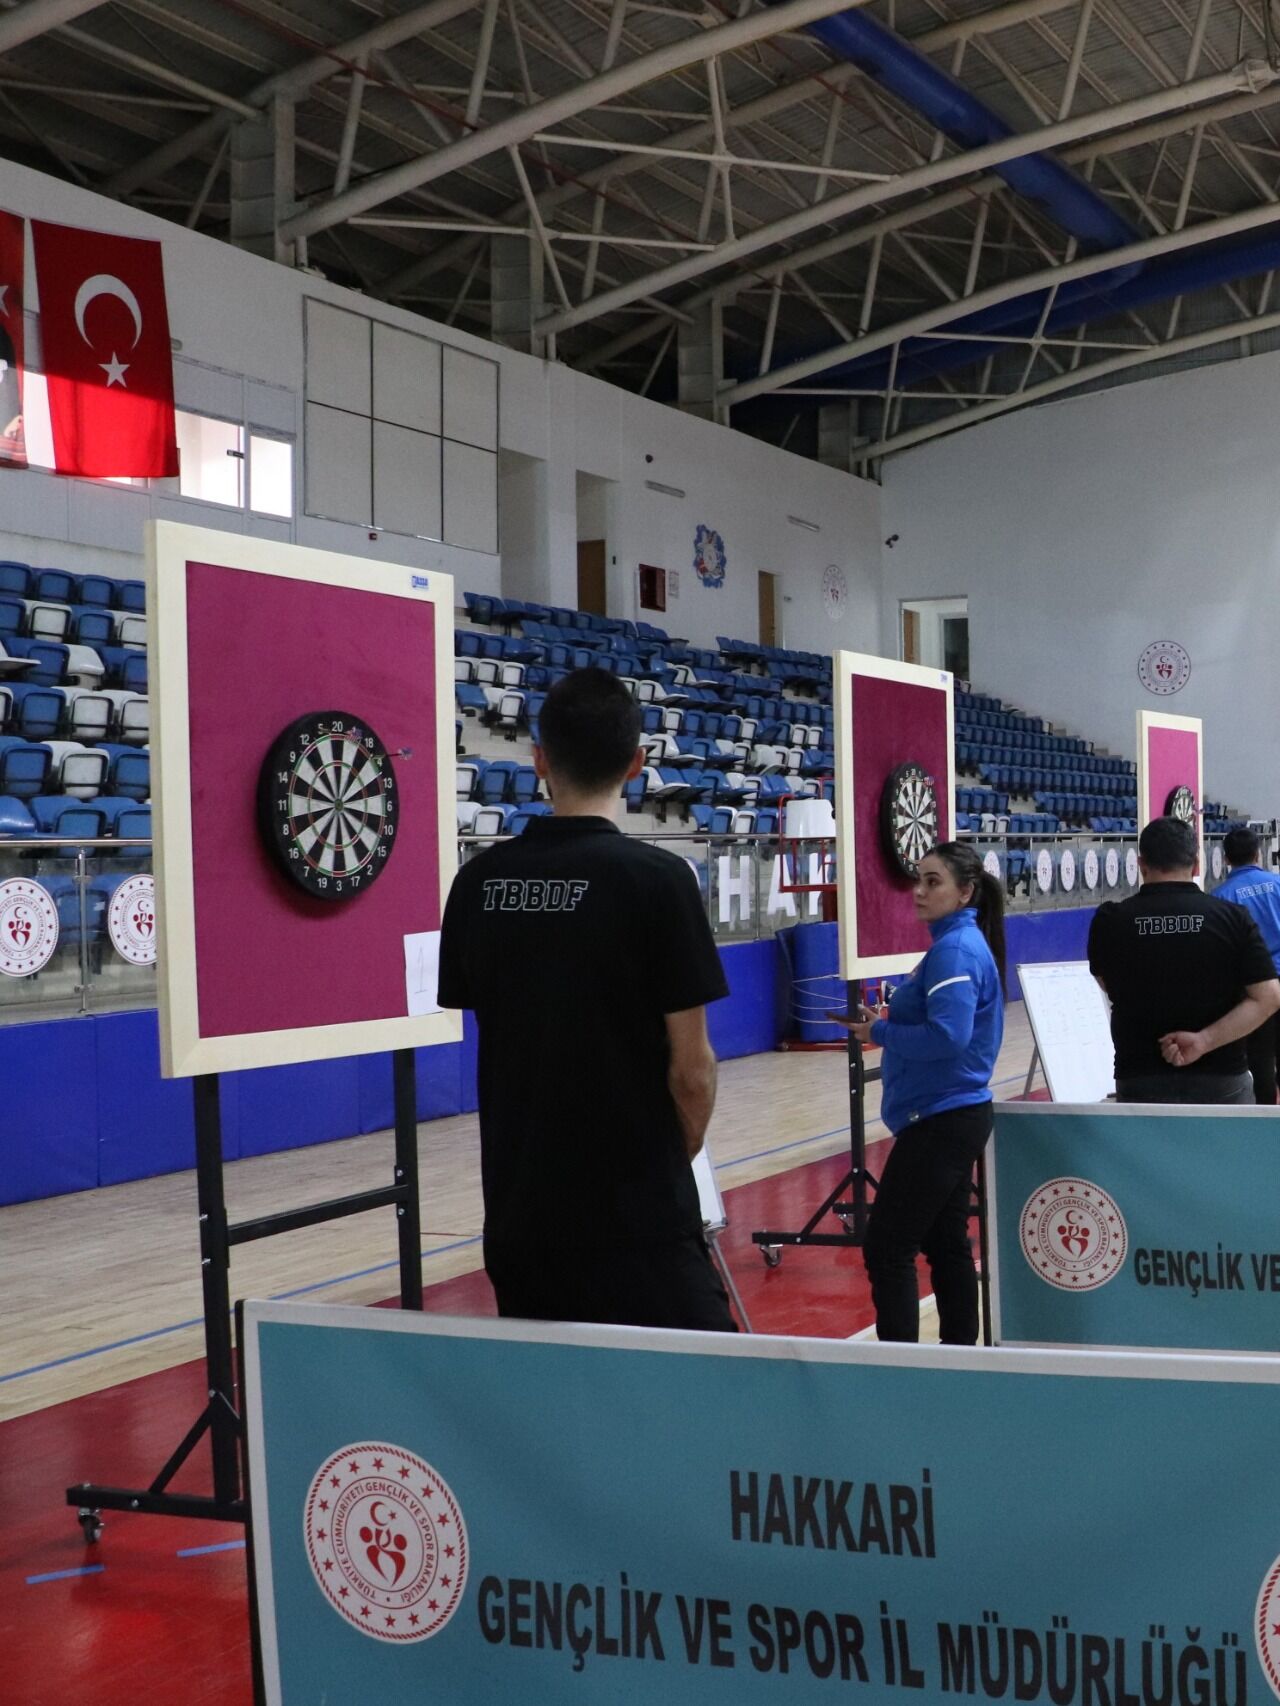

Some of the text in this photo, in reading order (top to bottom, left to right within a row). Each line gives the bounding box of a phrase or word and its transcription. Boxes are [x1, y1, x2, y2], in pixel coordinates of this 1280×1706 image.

[318, 723, 324, 734] 5
[332, 721, 343, 732] 20
[300, 734, 310, 745] 12
[365, 737, 374, 748] 18
[289, 751, 296, 762] 9
[278, 772, 288, 783] 14
[383, 777, 393, 788] 13
[278, 800, 287, 810] 11
[386, 801, 393, 811] 6
[283, 824, 289, 835] 8
[383, 825, 394, 835] 10
[288, 847, 299, 859] 16
[376, 846, 387, 857] 15
[304, 866, 310, 877] 7
[367, 865, 373, 876] 2
[317, 878, 327, 888] 19
[336, 880, 342, 891] 3
[350, 876, 360, 887] 17
[483, 879, 589, 911] TBBDF
[1135, 915, 1204, 935] TBBDF
[1134, 1242, 1245, 1298] GENÇLİK
[729, 1467, 937, 1559] HAKKARİ
[335, 1481, 434, 1603] TÜRKİYE CUMHURİYETİ GENÇLİK VE SPOR BAKANLIĞI
[477, 1571, 1248, 1706] GENÇLİK VE SPOR İL MÜDÜRLÜĞÜ
